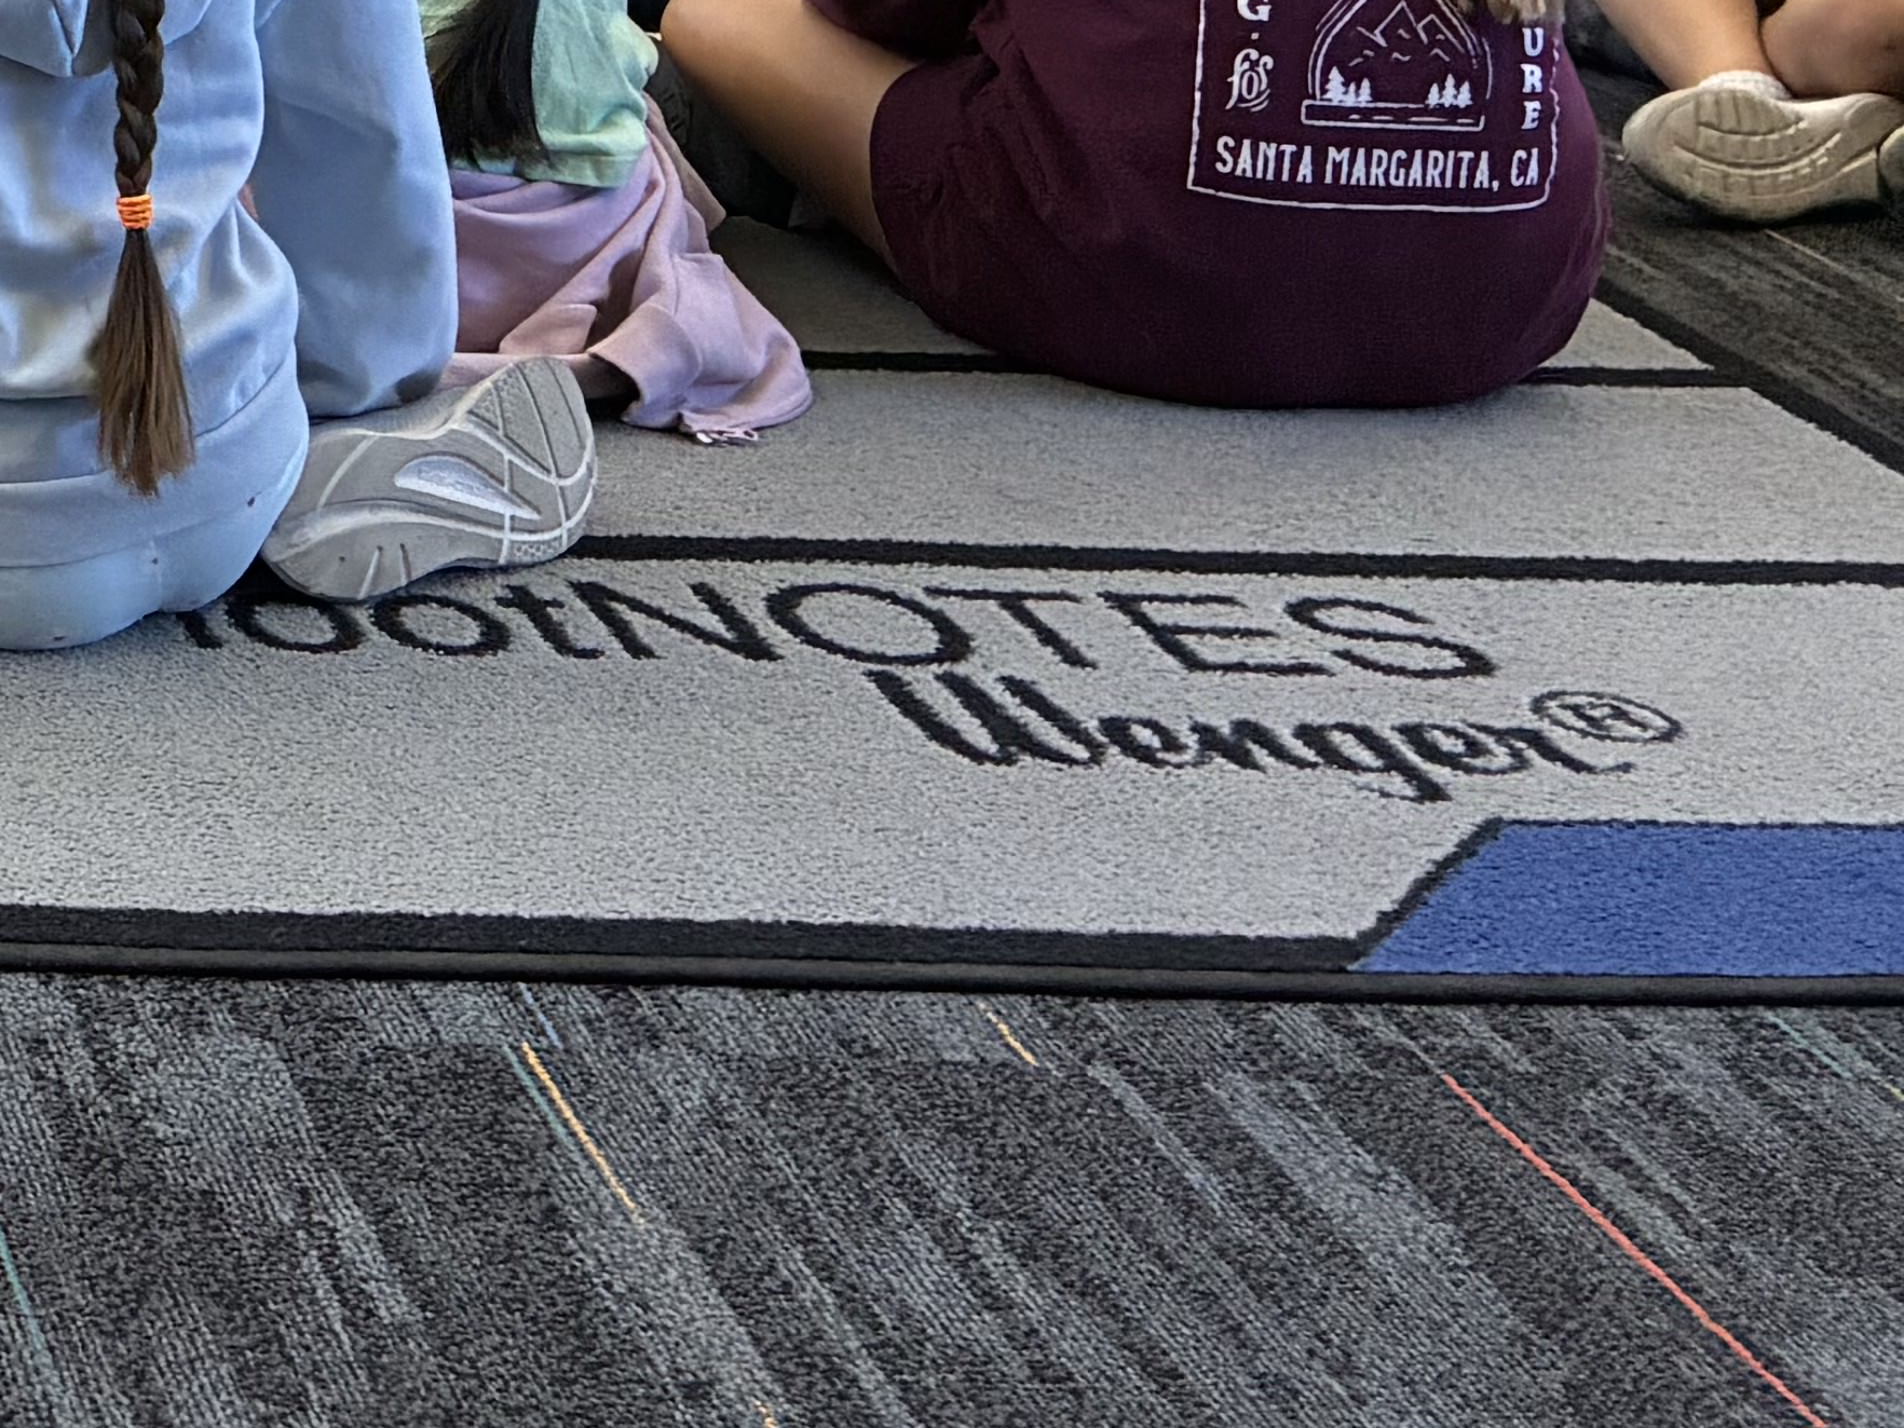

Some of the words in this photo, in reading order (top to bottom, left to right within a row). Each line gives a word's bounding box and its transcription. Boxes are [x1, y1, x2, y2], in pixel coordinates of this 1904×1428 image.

[1215, 135, 1313, 184] SANTA
[1324, 146, 1500, 192] MARGARITA,
[1510, 147, 1540, 188] CA
